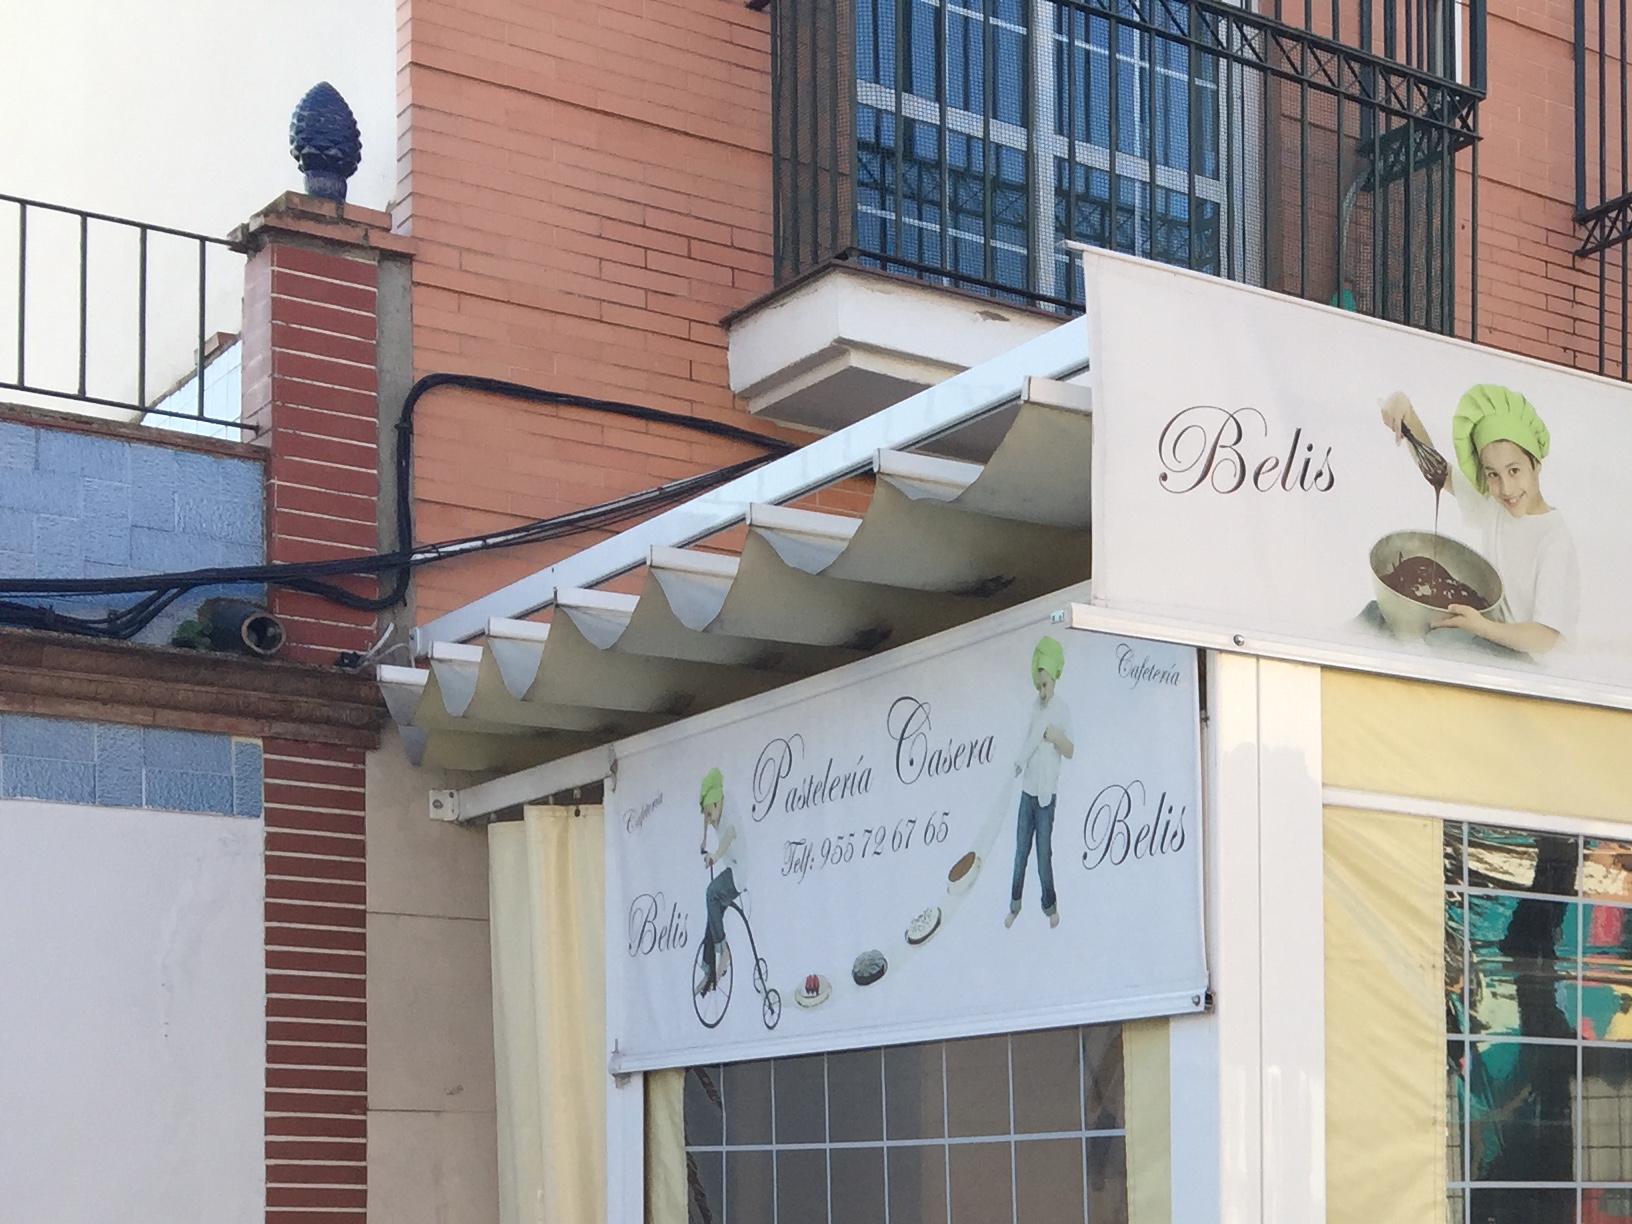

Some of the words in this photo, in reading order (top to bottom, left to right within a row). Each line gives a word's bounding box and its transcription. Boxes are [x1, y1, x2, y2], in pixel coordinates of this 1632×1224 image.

[1158, 405, 1336, 495] Belis
[1115, 643, 1181, 689] Cafetería
[751, 733, 873, 822] Pastelería
[886, 696, 997, 785] Casera
[781, 837, 816, 885] Telf:
[820, 832, 856, 870] 955
[1082, 779, 1187, 870] Belis
[627, 891, 689, 958] Belis
